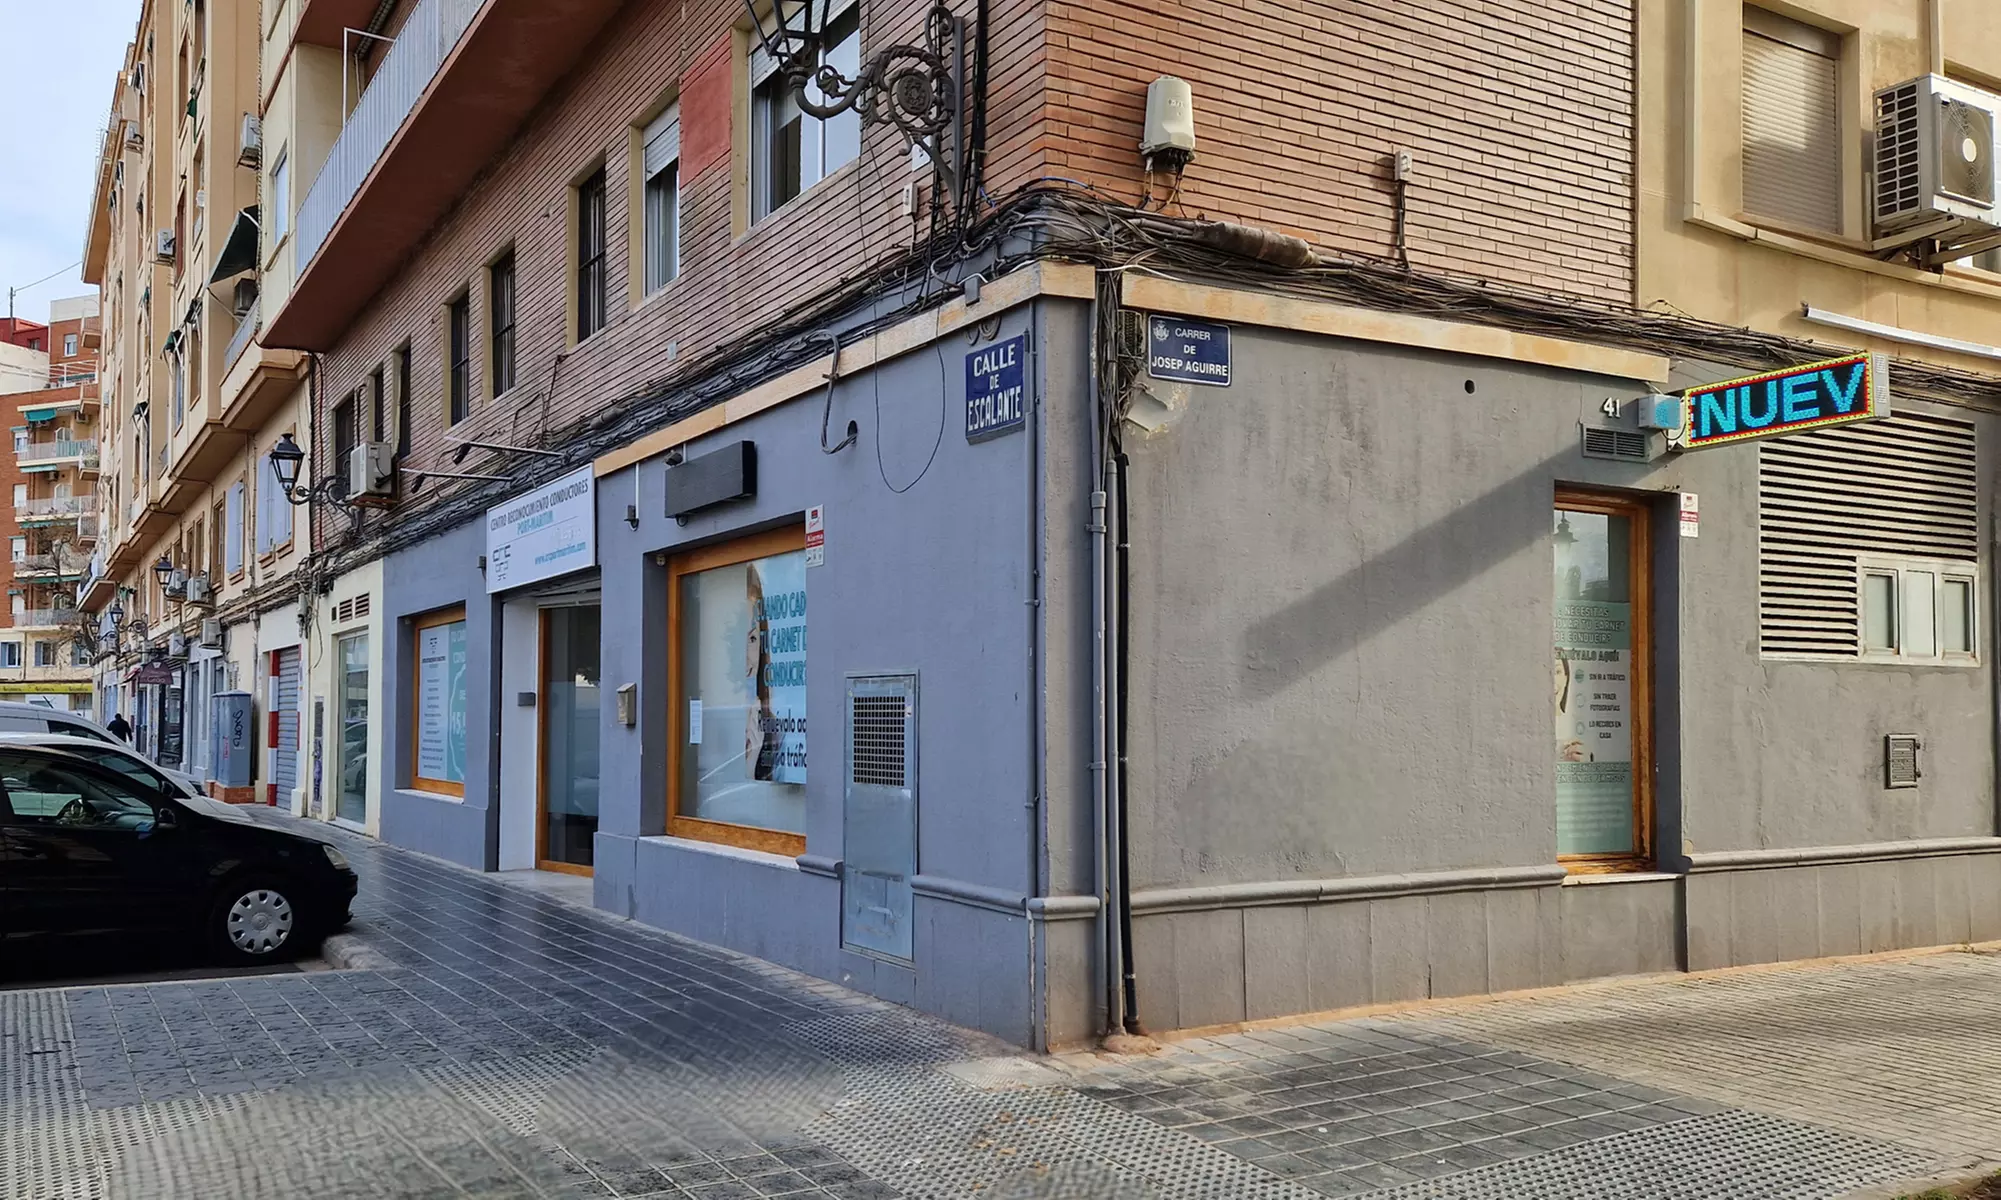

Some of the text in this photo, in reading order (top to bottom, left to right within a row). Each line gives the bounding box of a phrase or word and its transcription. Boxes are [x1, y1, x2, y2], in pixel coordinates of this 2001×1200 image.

[1175, 328, 1211, 341] CARRER
[973, 343, 1016, 377] CALLE
[1183, 344, 1197, 355] DE
[1152, 356, 1228, 376] JOSEP AGUIRRE
[989, 374, 999, 390] DE
[968, 385, 1022, 432] ESCALANTE
[1602, 396, 1621, 418] 41
[1691, 362, 1866, 438] NUEV
[490, 514, 507, 531] CENTRO
[550, 478, 589, 506] CONDUCTORES
